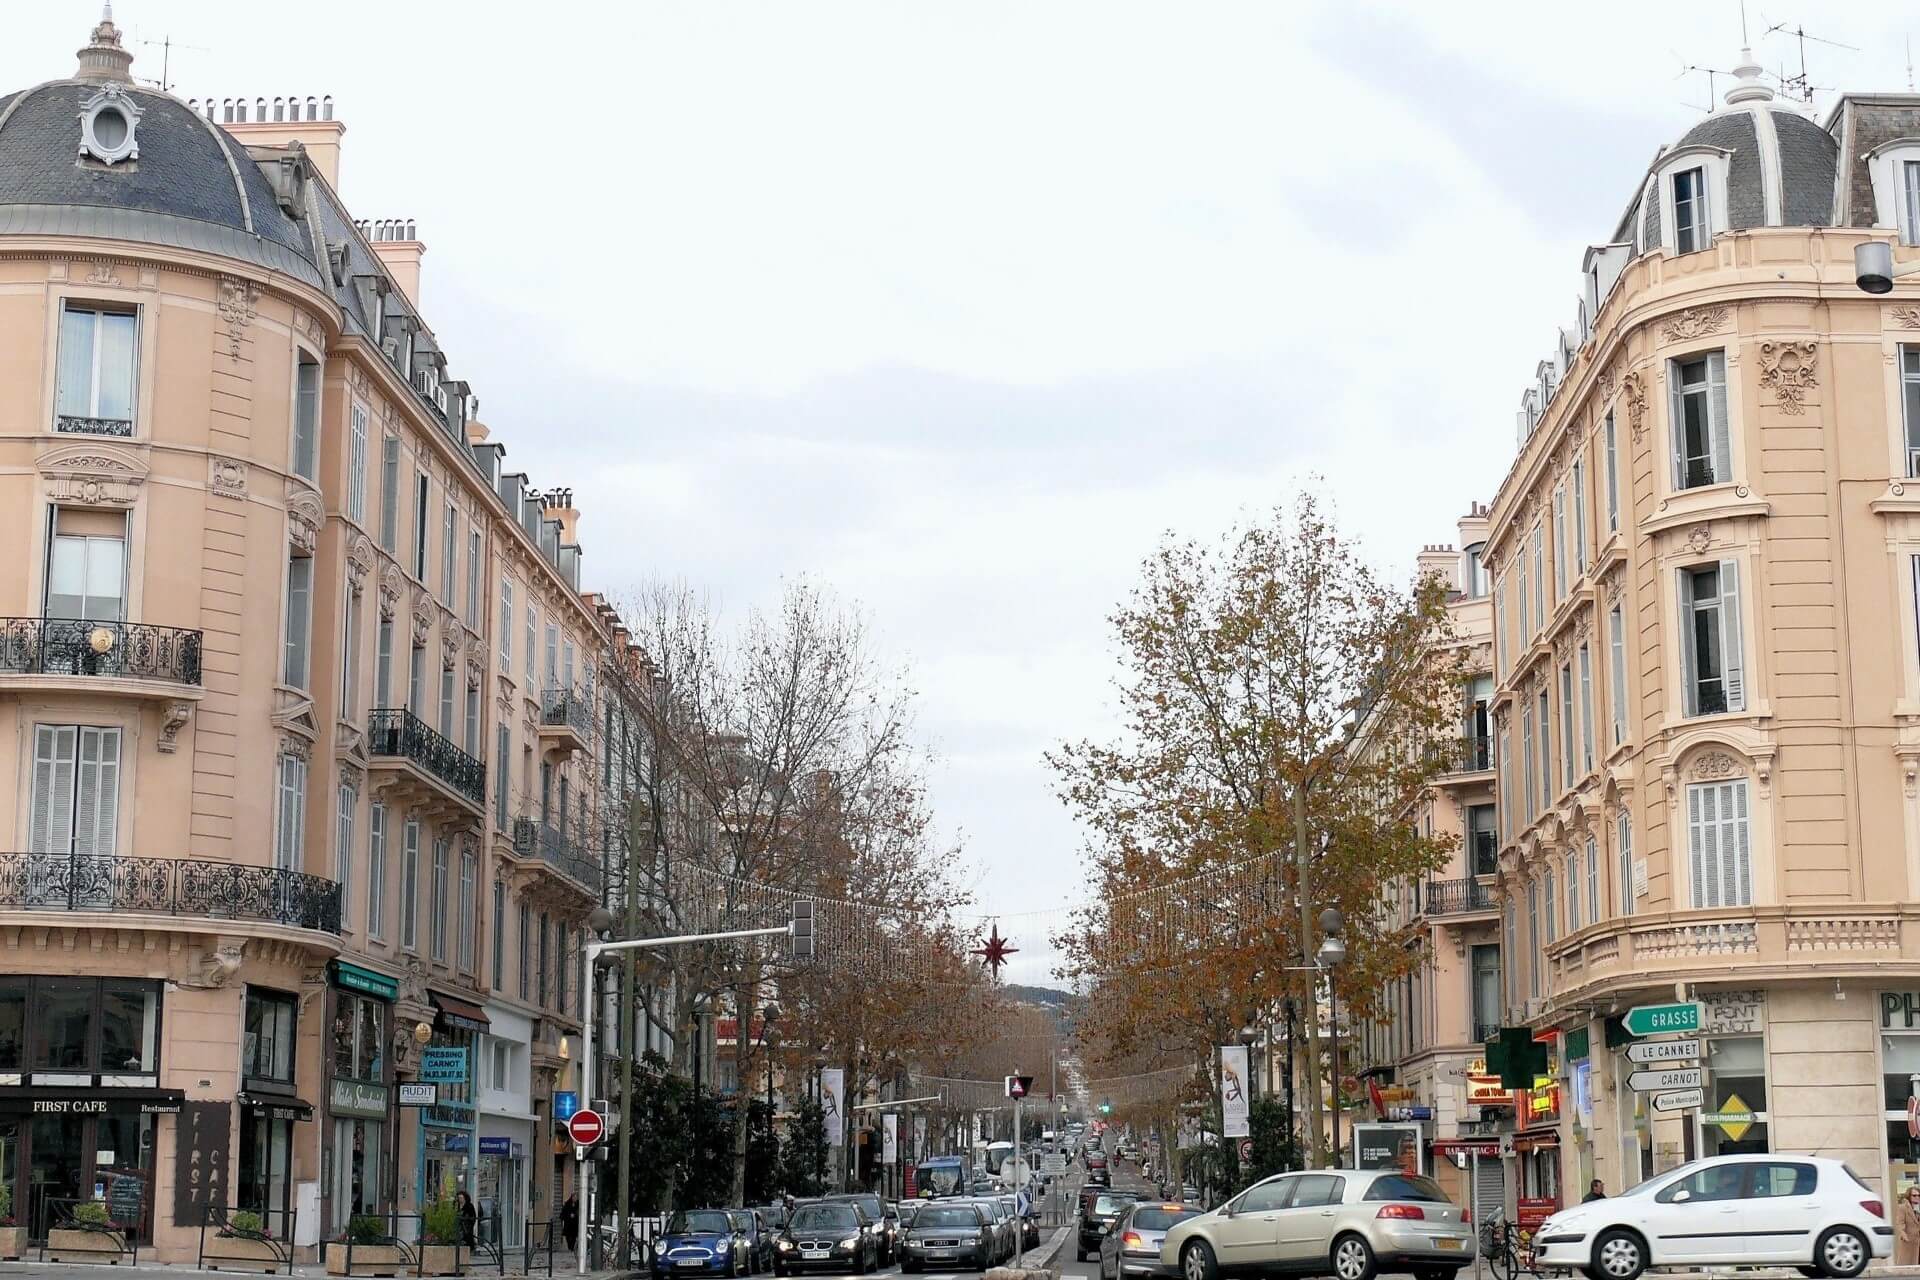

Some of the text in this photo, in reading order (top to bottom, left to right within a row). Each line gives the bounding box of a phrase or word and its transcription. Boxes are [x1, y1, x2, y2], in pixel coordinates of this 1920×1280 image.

[1714, 1005, 1758, 1019] PONT
[1651, 1010, 1696, 1027] GRASSE
[1699, 1020, 1755, 1033] ARNOT
[424, 1050, 463, 1058] PRESSING
[1642, 1044, 1697, 1058] LE CANNET
[427, 1060, 460, 1068] CARNOT
[1661, 1072, 1698, 1085] CARNOT
[402, 1086, 432, 1097] AUDIT
[1474, 1087, 1506, 1097] CHINA TOWN
[33, 1101, 107, 1113] FIRST CAFE
[140, 1104, 181, 1113] Restaurant
[190, 1112, 201, 1203] FIRST
